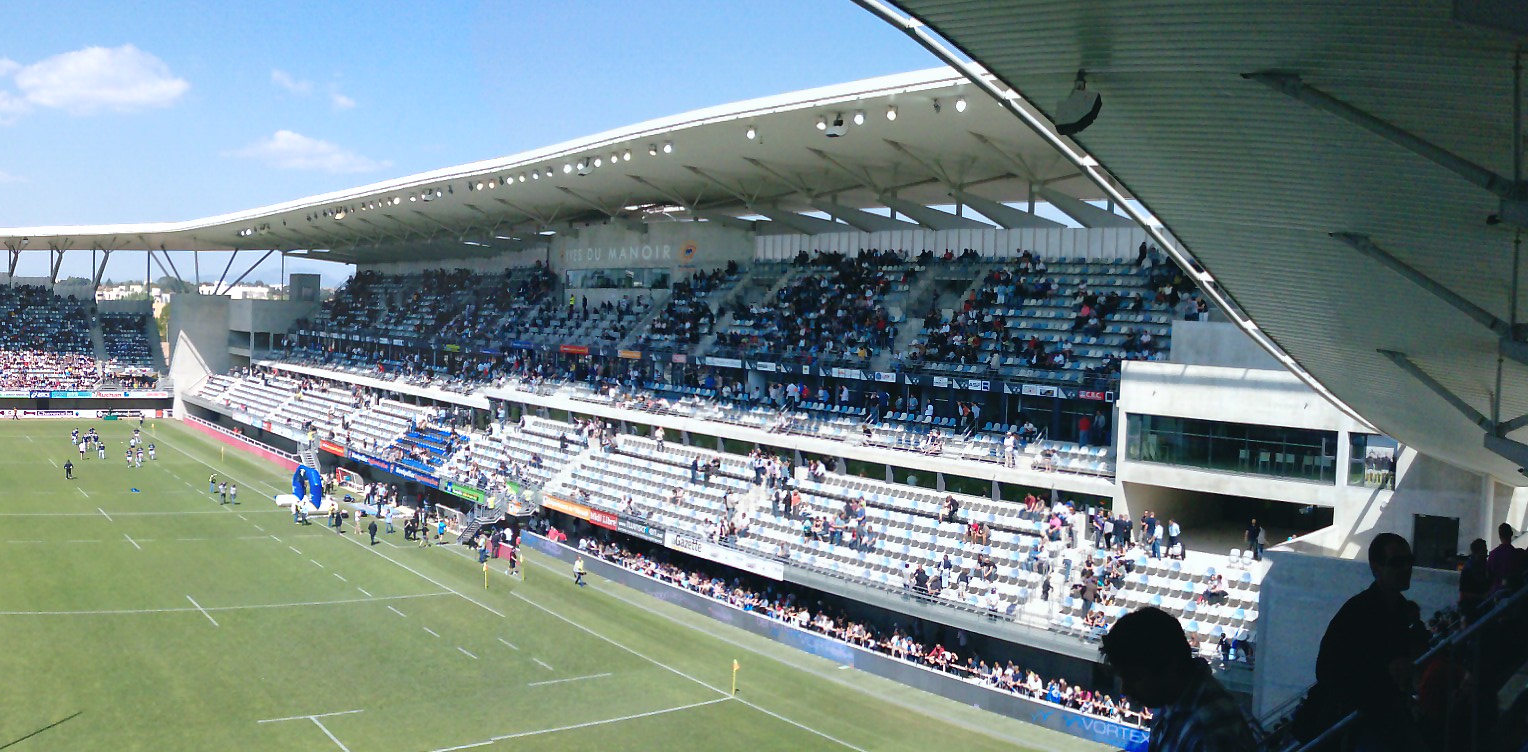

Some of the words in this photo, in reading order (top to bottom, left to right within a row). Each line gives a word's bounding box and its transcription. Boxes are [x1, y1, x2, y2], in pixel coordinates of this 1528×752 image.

[588, 248, 601, 261] DU
[608, 245, 671, 261] MANOIR
[590, 511, 602, 523] Midi
[602, 514, 617, 528] Libre
[675, 534, 702, 552] Gazette
[1081, 718, 1150, 744] VORTEX
